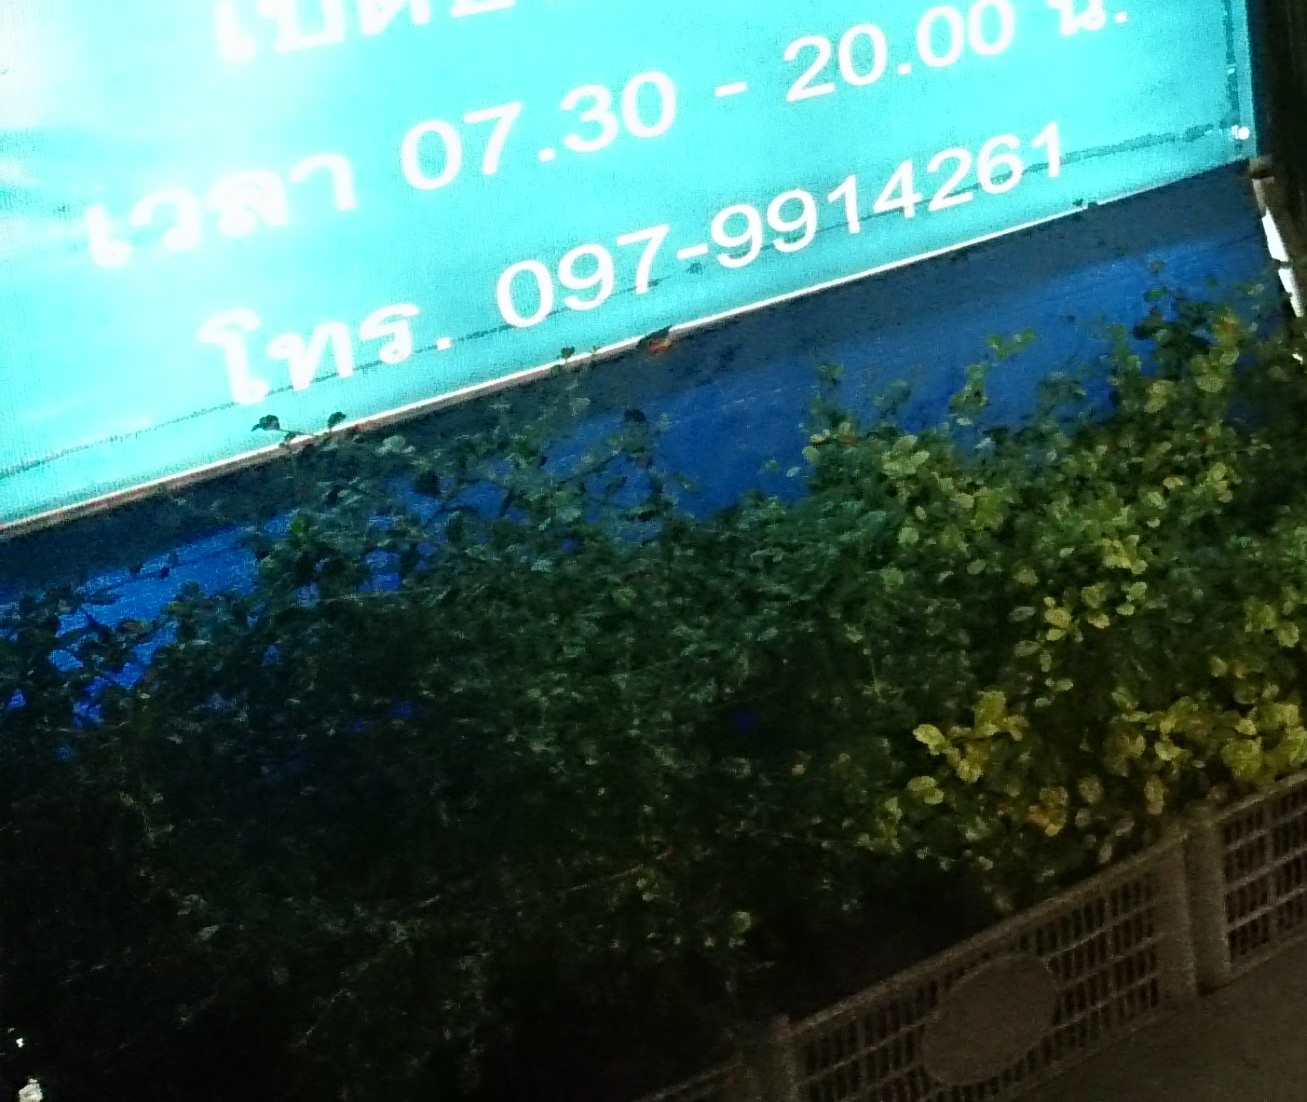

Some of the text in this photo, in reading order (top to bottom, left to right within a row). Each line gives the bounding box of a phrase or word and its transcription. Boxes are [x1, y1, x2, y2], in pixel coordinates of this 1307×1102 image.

[87, 152, 358, 269] เวลา
[399, 70, 678, 191] 07.30
[198, 120, 1063, 407] โทร. 097-9914261
